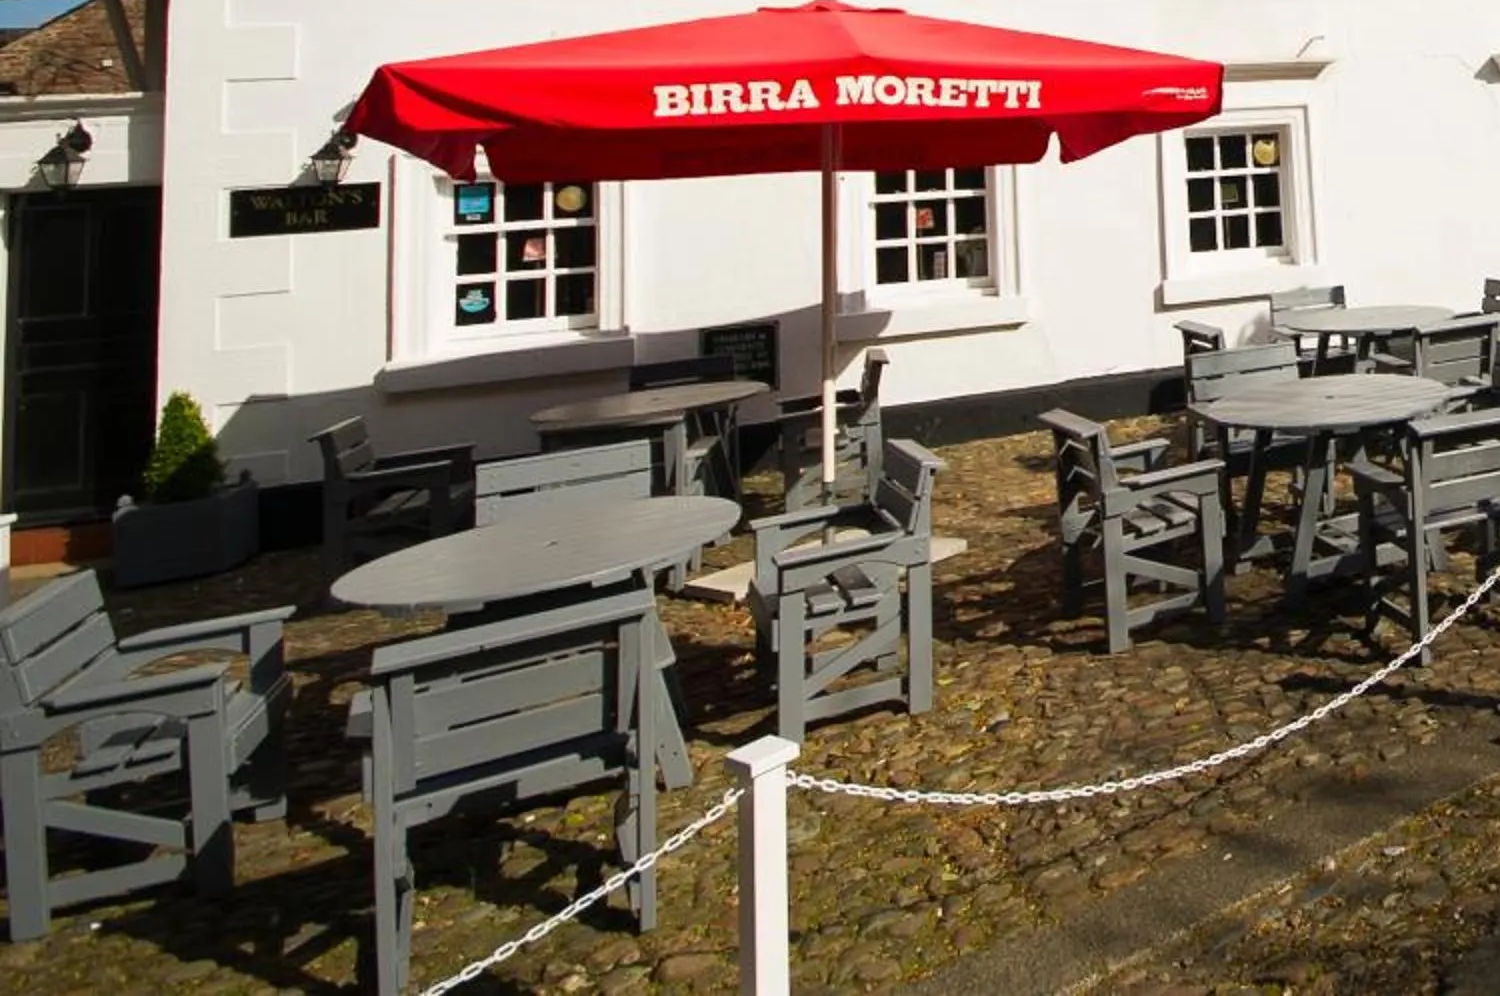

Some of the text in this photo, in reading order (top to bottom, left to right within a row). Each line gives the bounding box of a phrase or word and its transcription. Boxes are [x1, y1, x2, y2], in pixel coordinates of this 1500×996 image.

[653, 75, 1042, 117] BIRRA MORETTI
[285, 209, 329, 226] BAR
